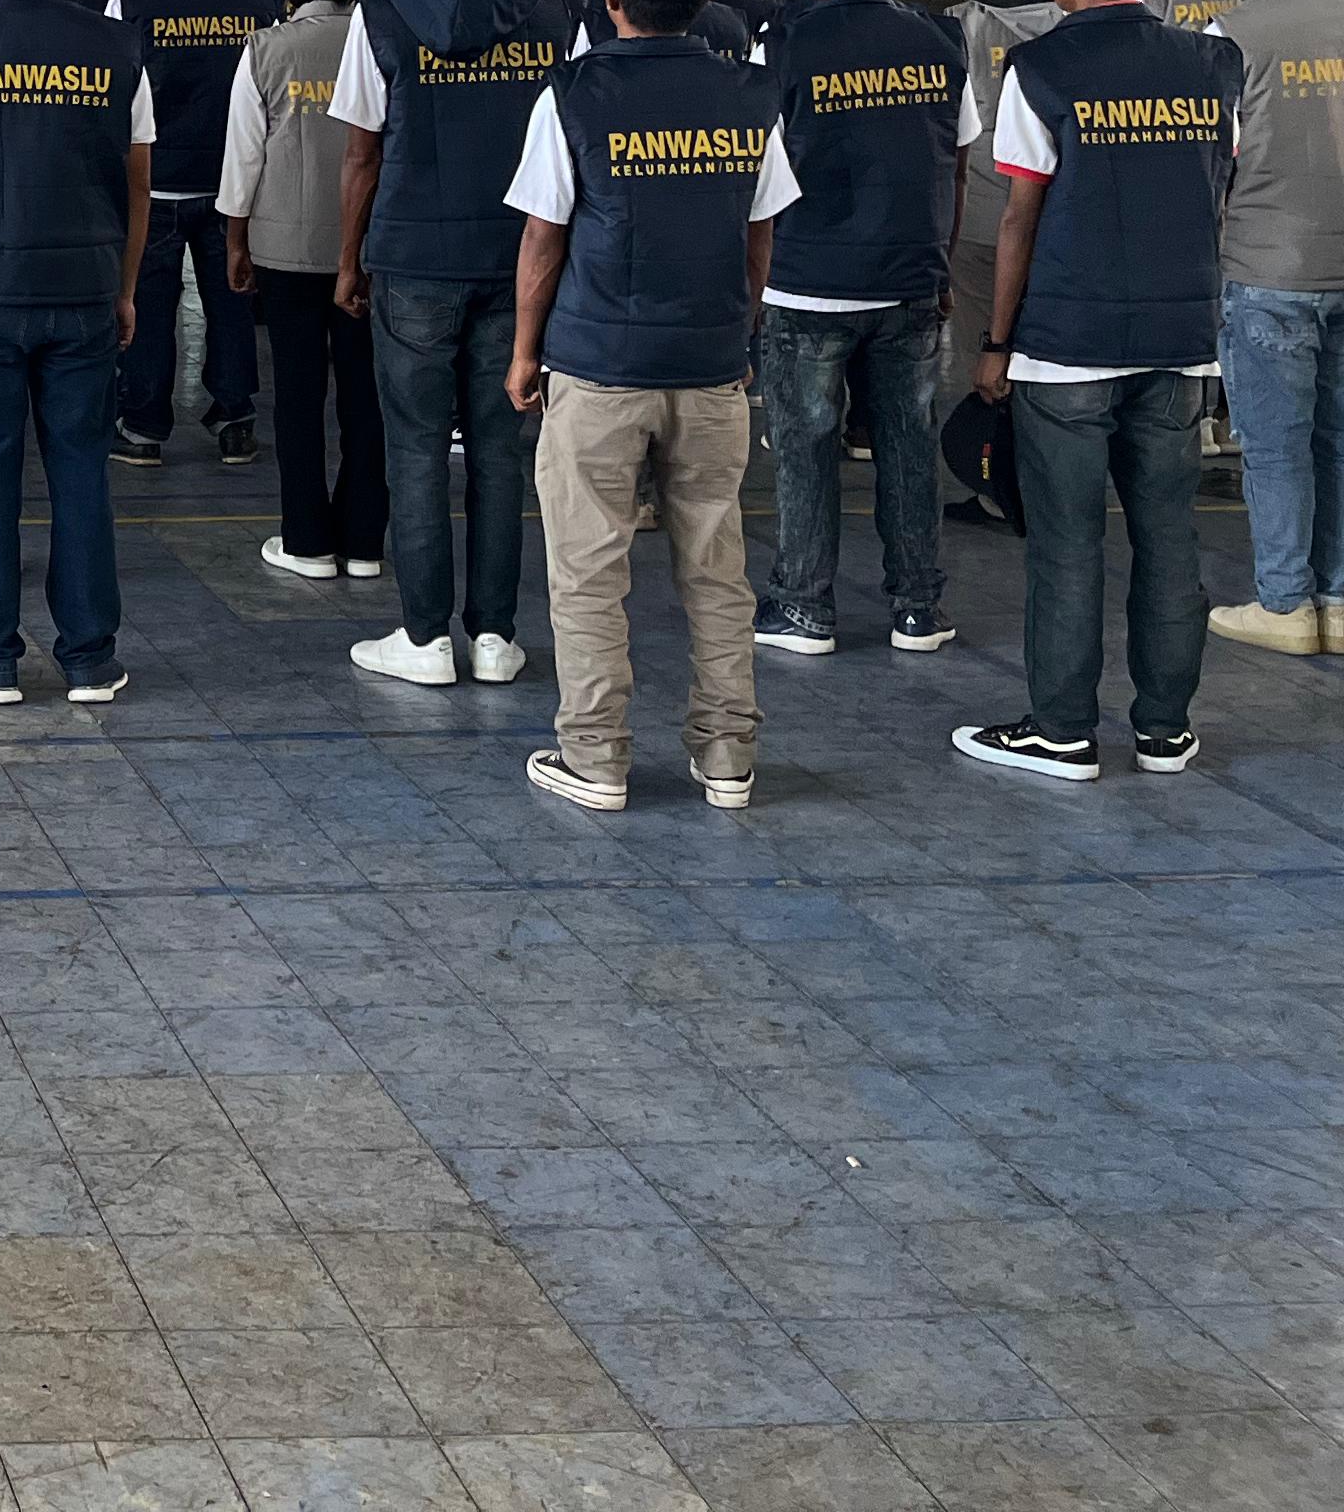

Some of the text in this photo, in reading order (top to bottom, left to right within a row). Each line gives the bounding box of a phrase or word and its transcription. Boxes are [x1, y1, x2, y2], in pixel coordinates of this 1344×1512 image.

[153, 16, 255, 37] PANWASLU
[153, 38, 248, 47] KELURAHAN/DE
[811, 65, 949, 100] PANWASLU
[1279, 59, 1344, 86] PANW
[814, 93, 949, 114] KELURAHAN/DESA
[1073, 98, 1220, 129] PANWASLU
[608, 128, 766, 161] PANWASLU
[1080, 130, 1219, 144] KELURAHAN/DESA
